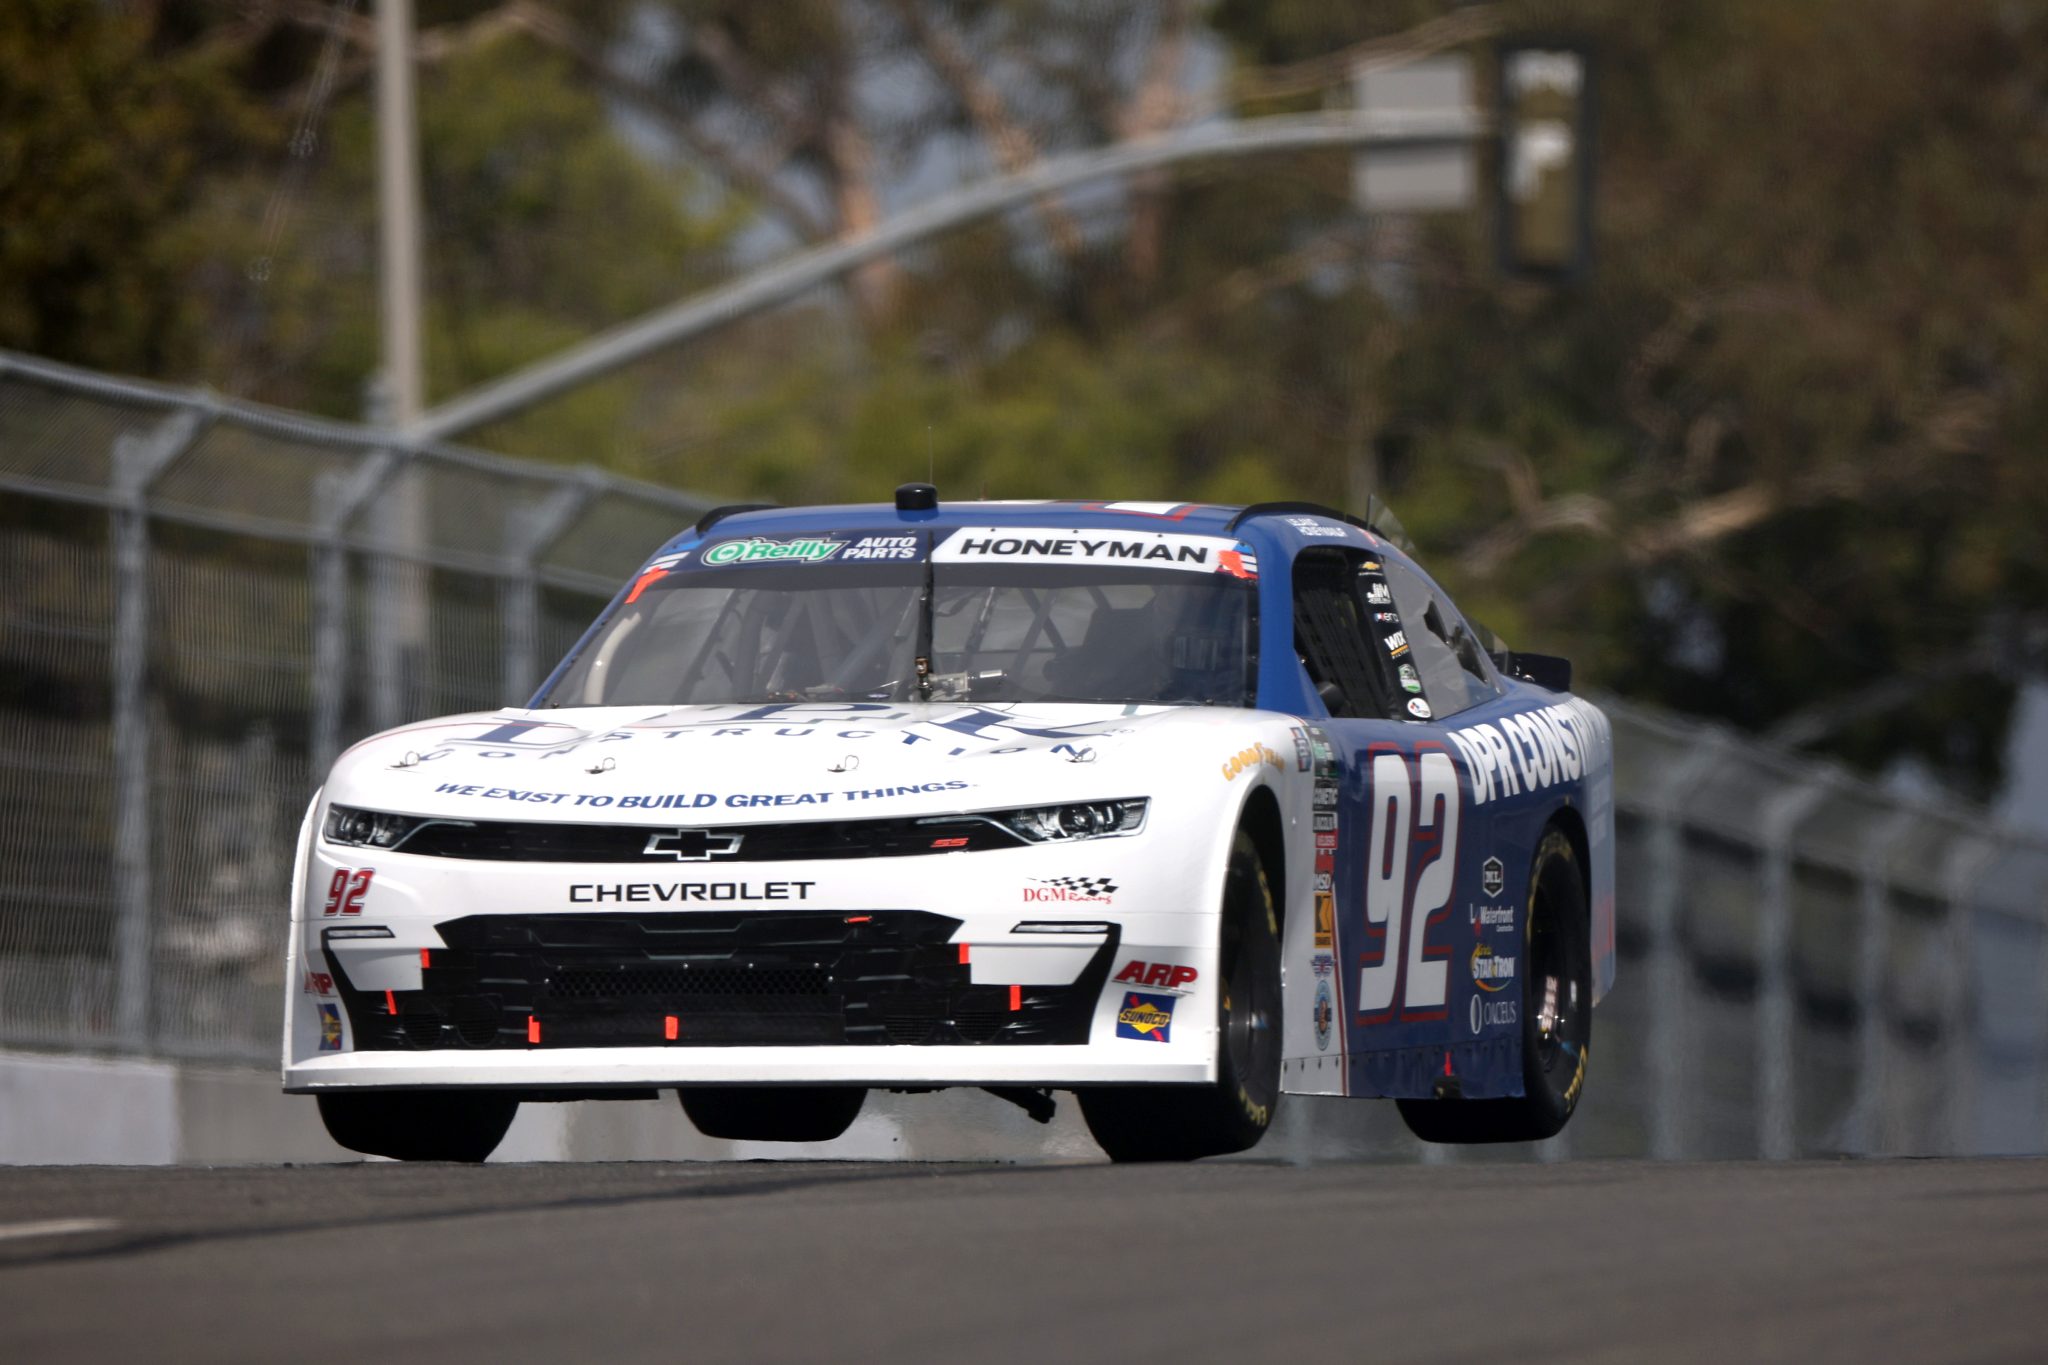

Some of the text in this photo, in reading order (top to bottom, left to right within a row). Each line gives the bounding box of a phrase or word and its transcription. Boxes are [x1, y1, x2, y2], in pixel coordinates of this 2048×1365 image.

[703, 536, 846, 567] O'Reilly
[841, 547, 917, 560] PARTS
[855, 536, 917, 548] AUTO
[959, 538, 1209, 564] HONEYMAN
[1384, 631, 1406, 651] WIX
[1446, 723, 1521, 806] DPR
[434, 783, 475, 798] WE
[480, 787, 570, 806] EXIST
[574, 794, 614, 808] TO
[616, 793, 718, 809] BUILD
[725, 791, 833, 808] GREAT
[930, 837, 969, 849] SS
[323, 867, 376, 917] 92
[569, 881, 817, 903] CHEVROLET
[1357, 748, 1462, 1016] 92
[1023, 887, 1113, 905] DGM Racing
[1112, 960, 1199, 988] ARP
[1120, 1009, 1169, 1025] SUNOCO
